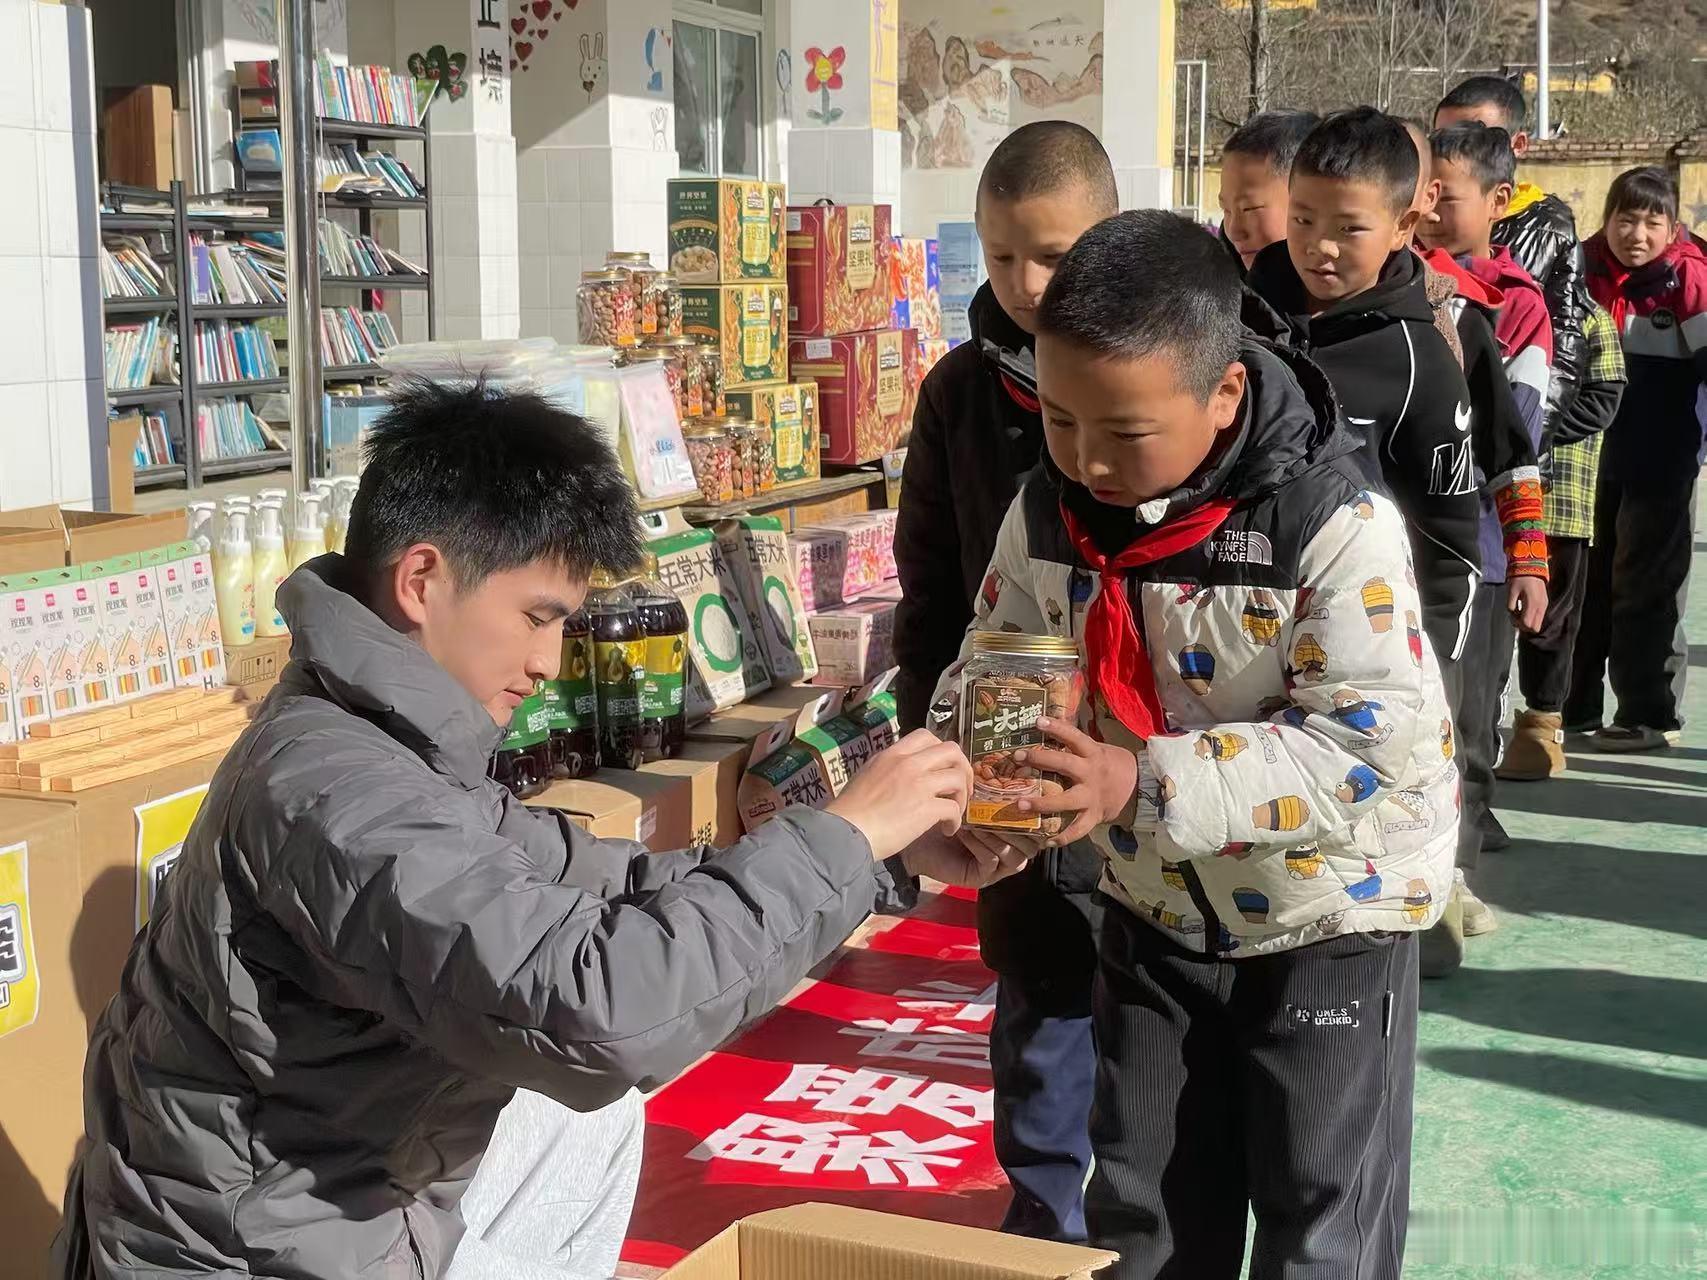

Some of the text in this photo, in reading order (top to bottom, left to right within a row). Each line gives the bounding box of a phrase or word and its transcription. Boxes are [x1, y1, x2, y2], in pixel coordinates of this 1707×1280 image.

[744, 533, 788, 564] 五常大米
[1224, 530, 1247, 541] THE
[659, 547, 727, 591] 五常大米
